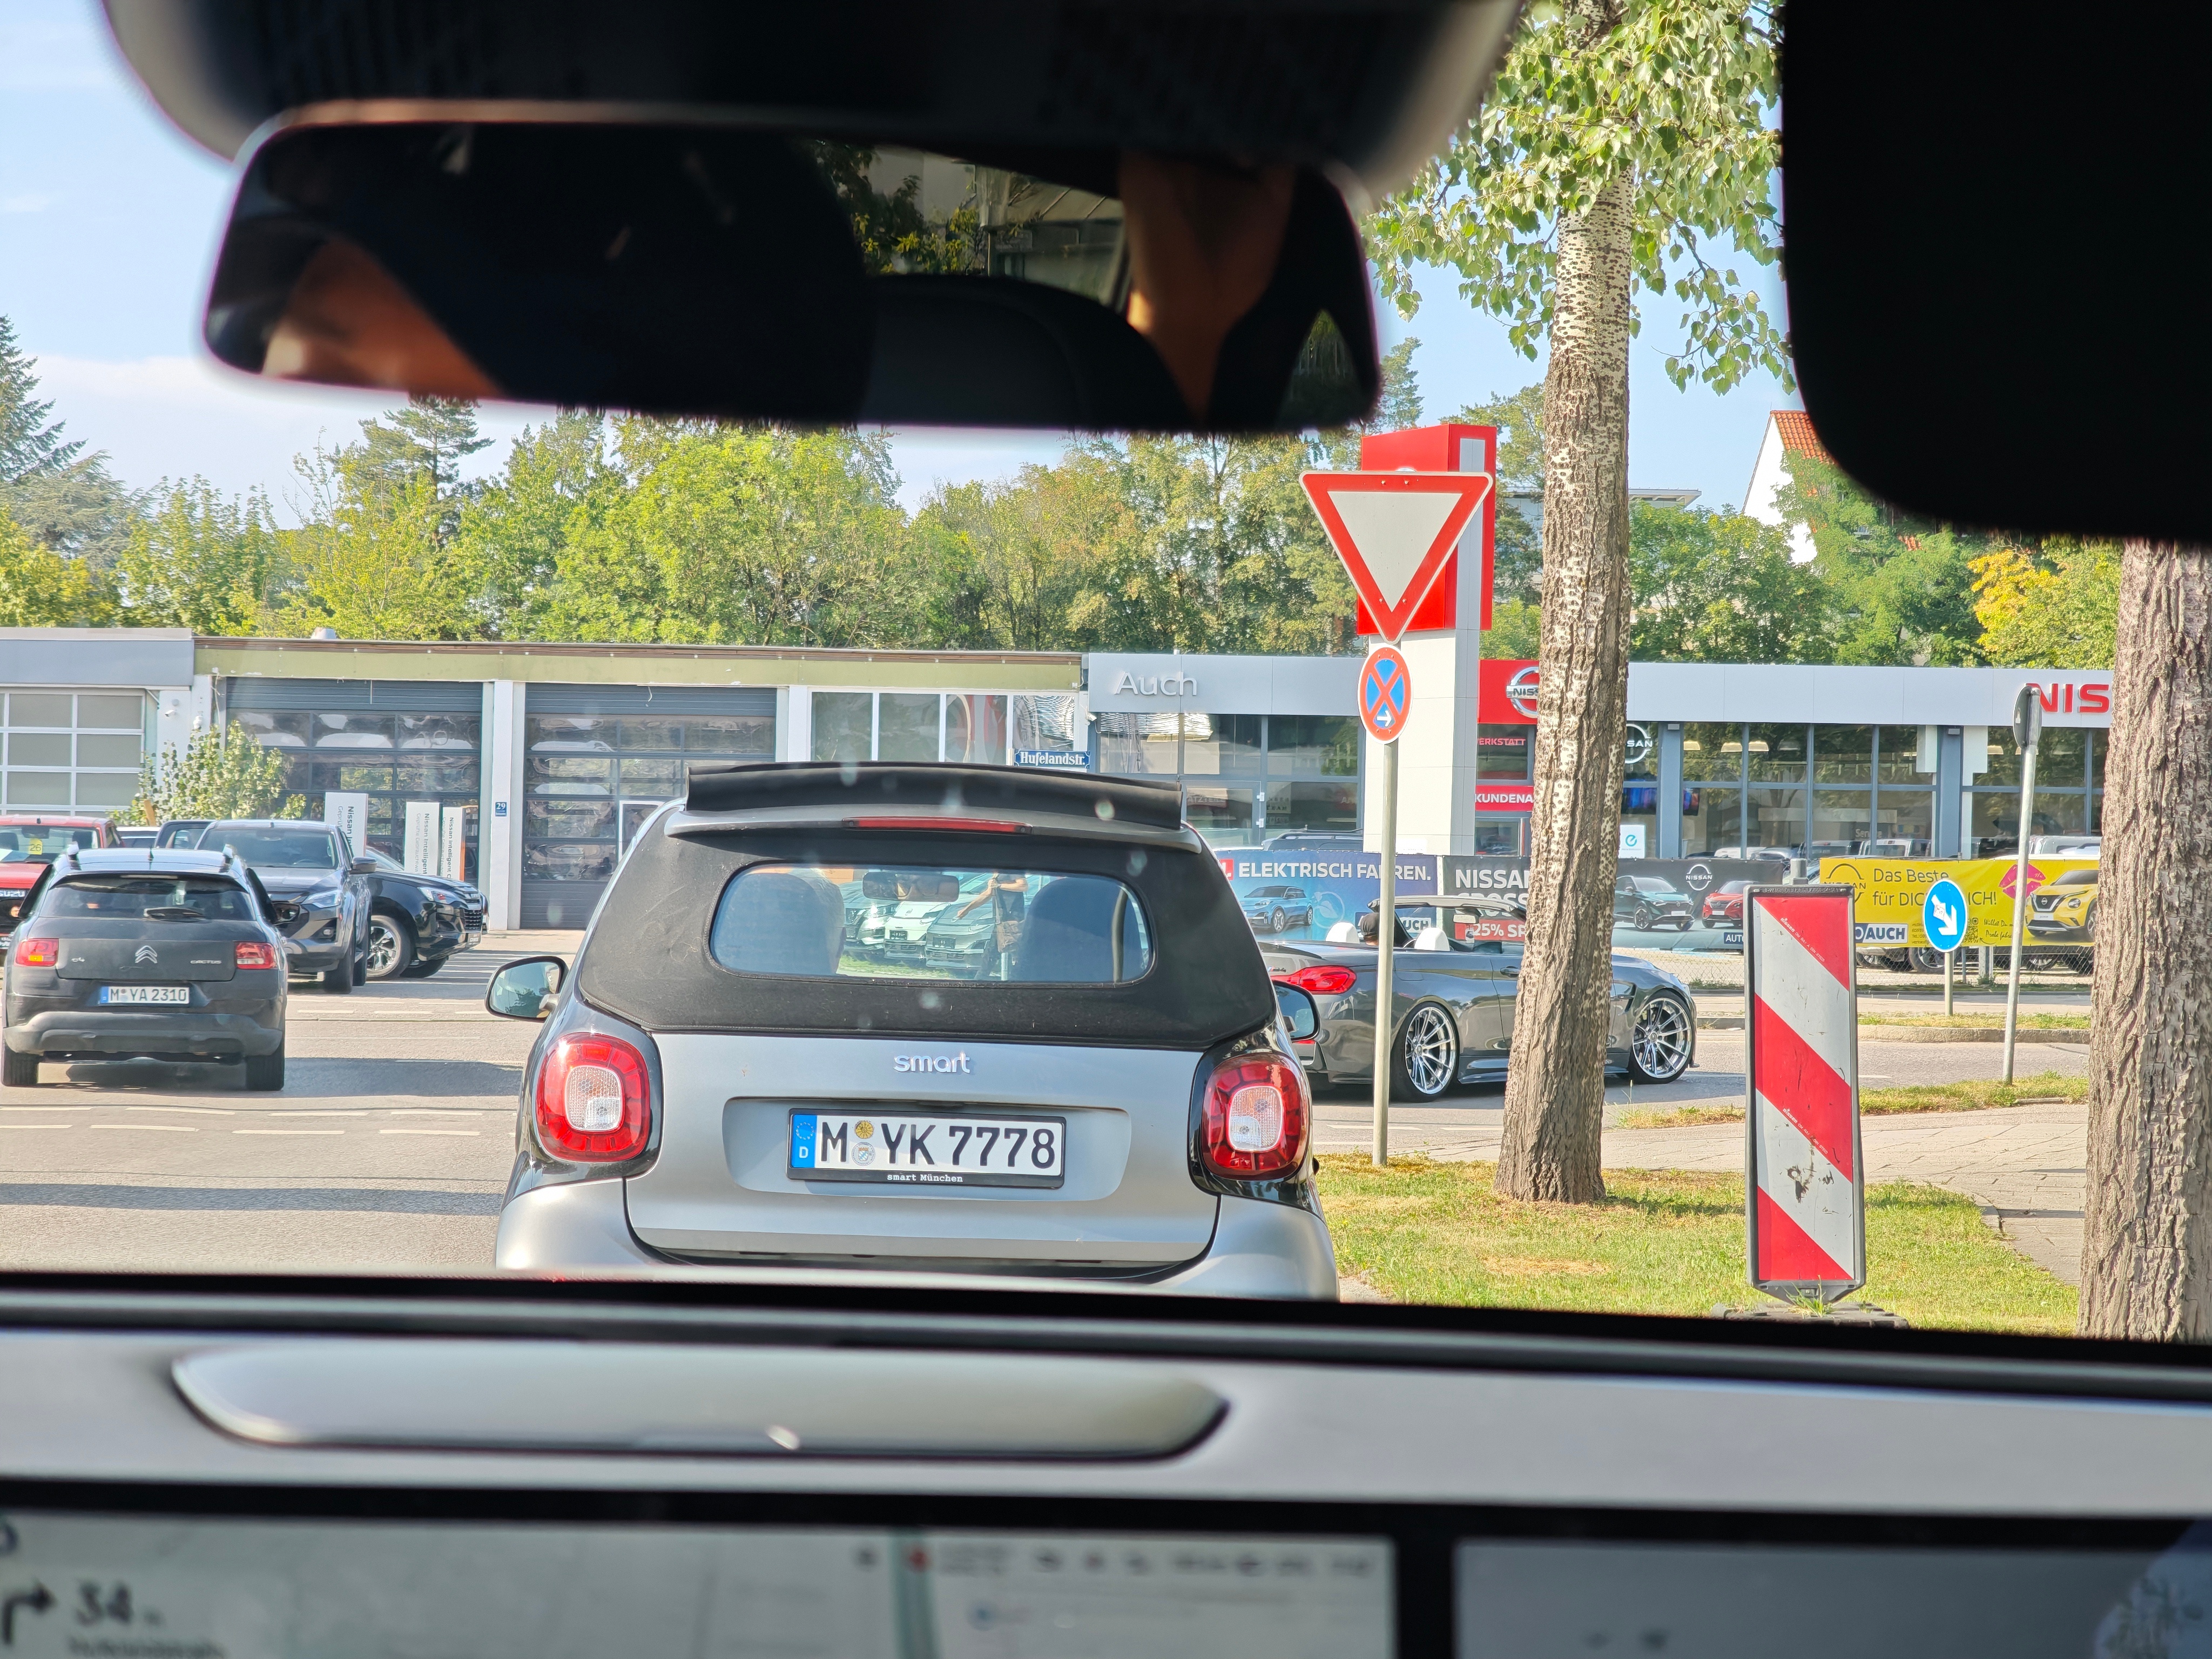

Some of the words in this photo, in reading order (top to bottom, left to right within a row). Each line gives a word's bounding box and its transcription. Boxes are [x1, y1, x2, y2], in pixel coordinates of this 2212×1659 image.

[1114, 671, 1197, 697] Auch
[1478, 738, 1526, 746] ERKSTATT
[1020, 751, 1086, 767] Hufelandstr.
[30, 844, 42, 852] 26
[1239, 862, 1352, 879] ELEKTRISCH
[1357, 864, 1432, 881] FAREN.
[1873, 868, 1902, 882] Das
[1907, 869, 1949, 883] Beste
[1872, 891, 1895, 907] für
[1899, 892, 1925, 907] DIC
[1968, 892, 1997, 906] ICH!
[1403, 920, 1429, 931] UCH
[1865, 927, 1906, 941] AUCH
[110, 988, 119, 1001] M
[130, 988, 147, 1001] YA
[151, 989, 187, 1002] 2310
[893, 1052, 971, 1074] smart
[820, 1121, 848, 1162] M
[881, 1123, 936, 1165] YK
[948, 1125, 1055, 1169] 7778
[799, 1147, 808, 1159] D
[887, 1173, 917, 1181] smart
[920, 1174, 963, 1182] München
